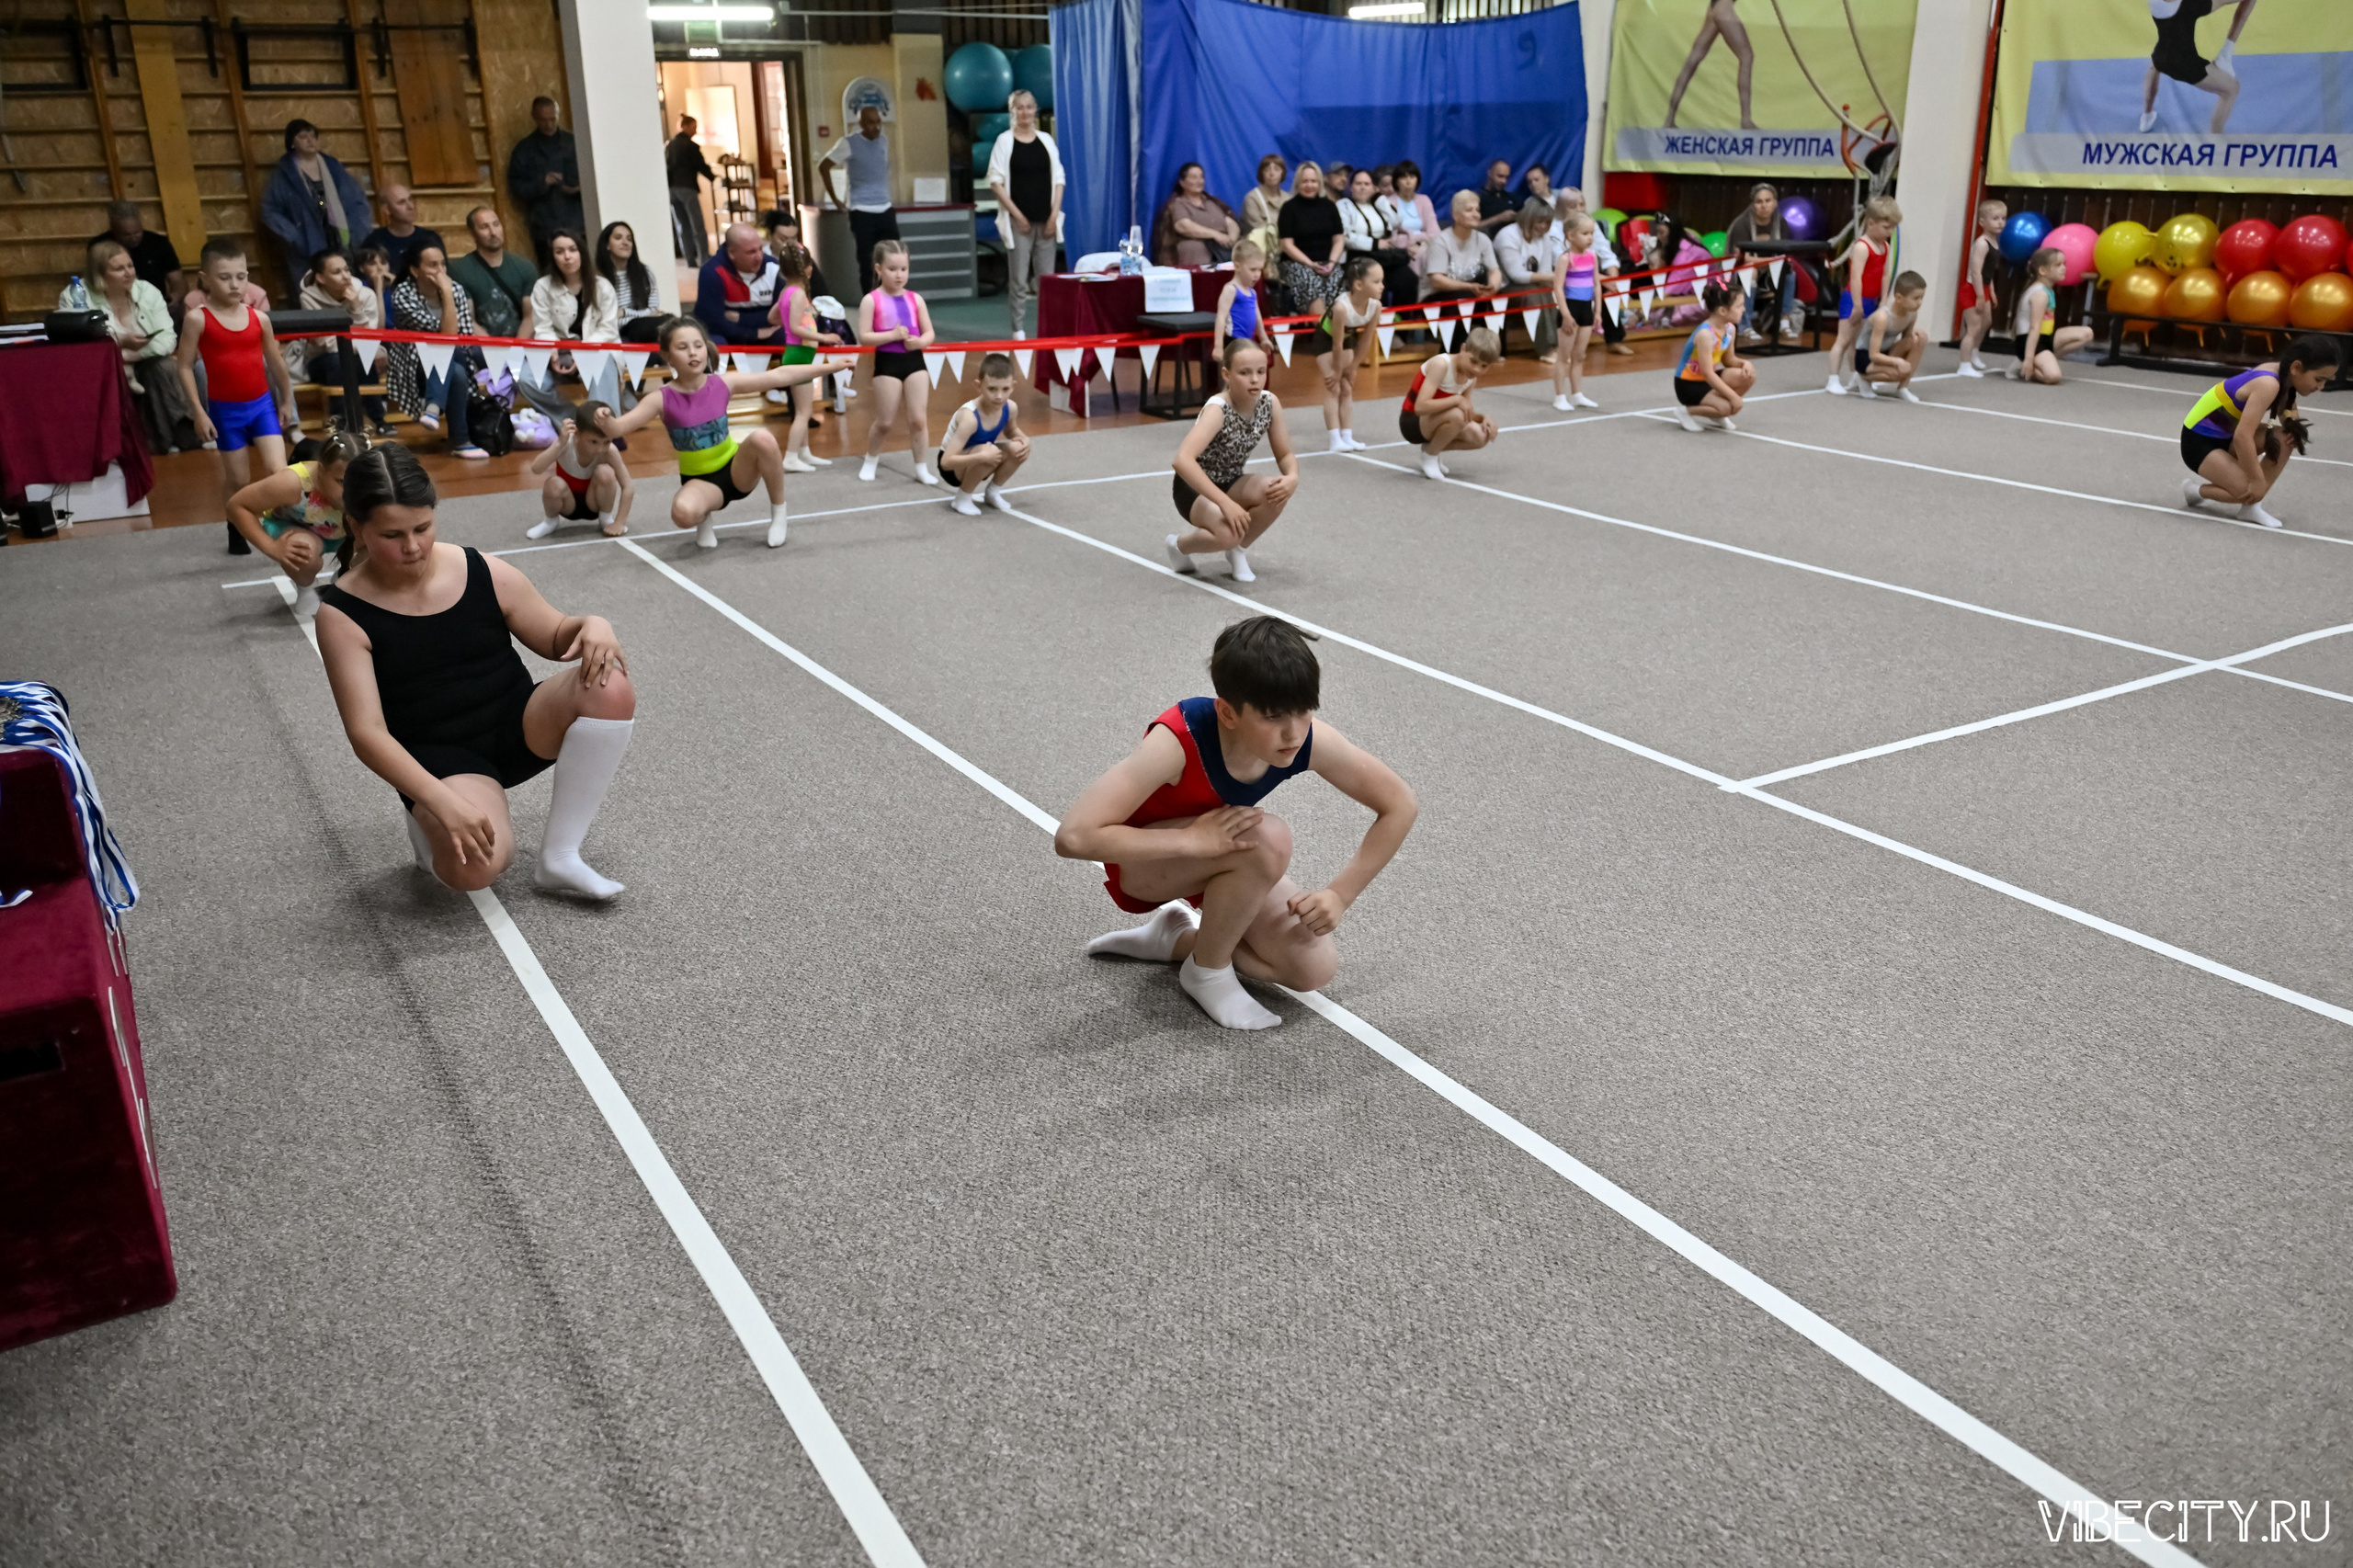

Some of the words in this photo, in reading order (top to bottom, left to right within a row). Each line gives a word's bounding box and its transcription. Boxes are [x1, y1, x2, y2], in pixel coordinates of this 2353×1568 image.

[1665, 136, 1754, 156] ЖЕНСКАЯ
[1759, 137, 1835, 157] ГРУППА
[2082, 142, 2216, 166] МУЖСКАЯ
[2223, 143, 2338, 168] ГРУППА
